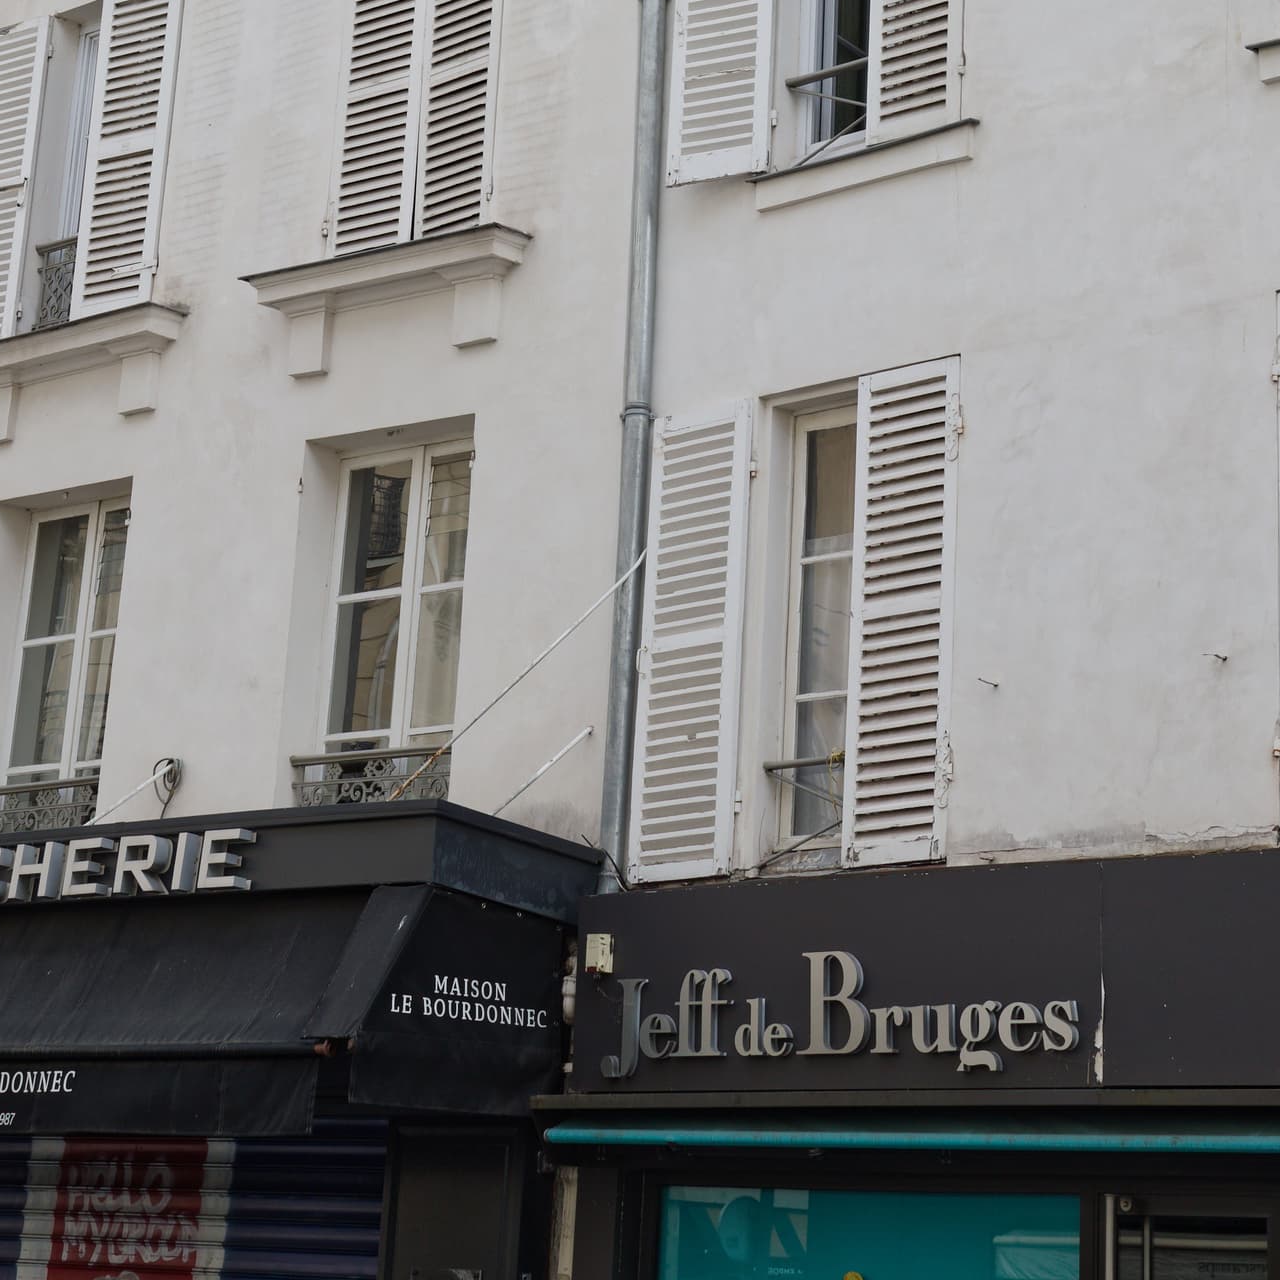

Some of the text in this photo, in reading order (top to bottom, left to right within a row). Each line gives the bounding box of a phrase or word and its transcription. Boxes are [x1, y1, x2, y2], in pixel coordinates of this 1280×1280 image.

[434, 974, 506, 1001] MAISON
[390, 993, 548, 1028] LE BOURDONNEC
[600, 949, 1080, 1079] Jeff de Bruges
